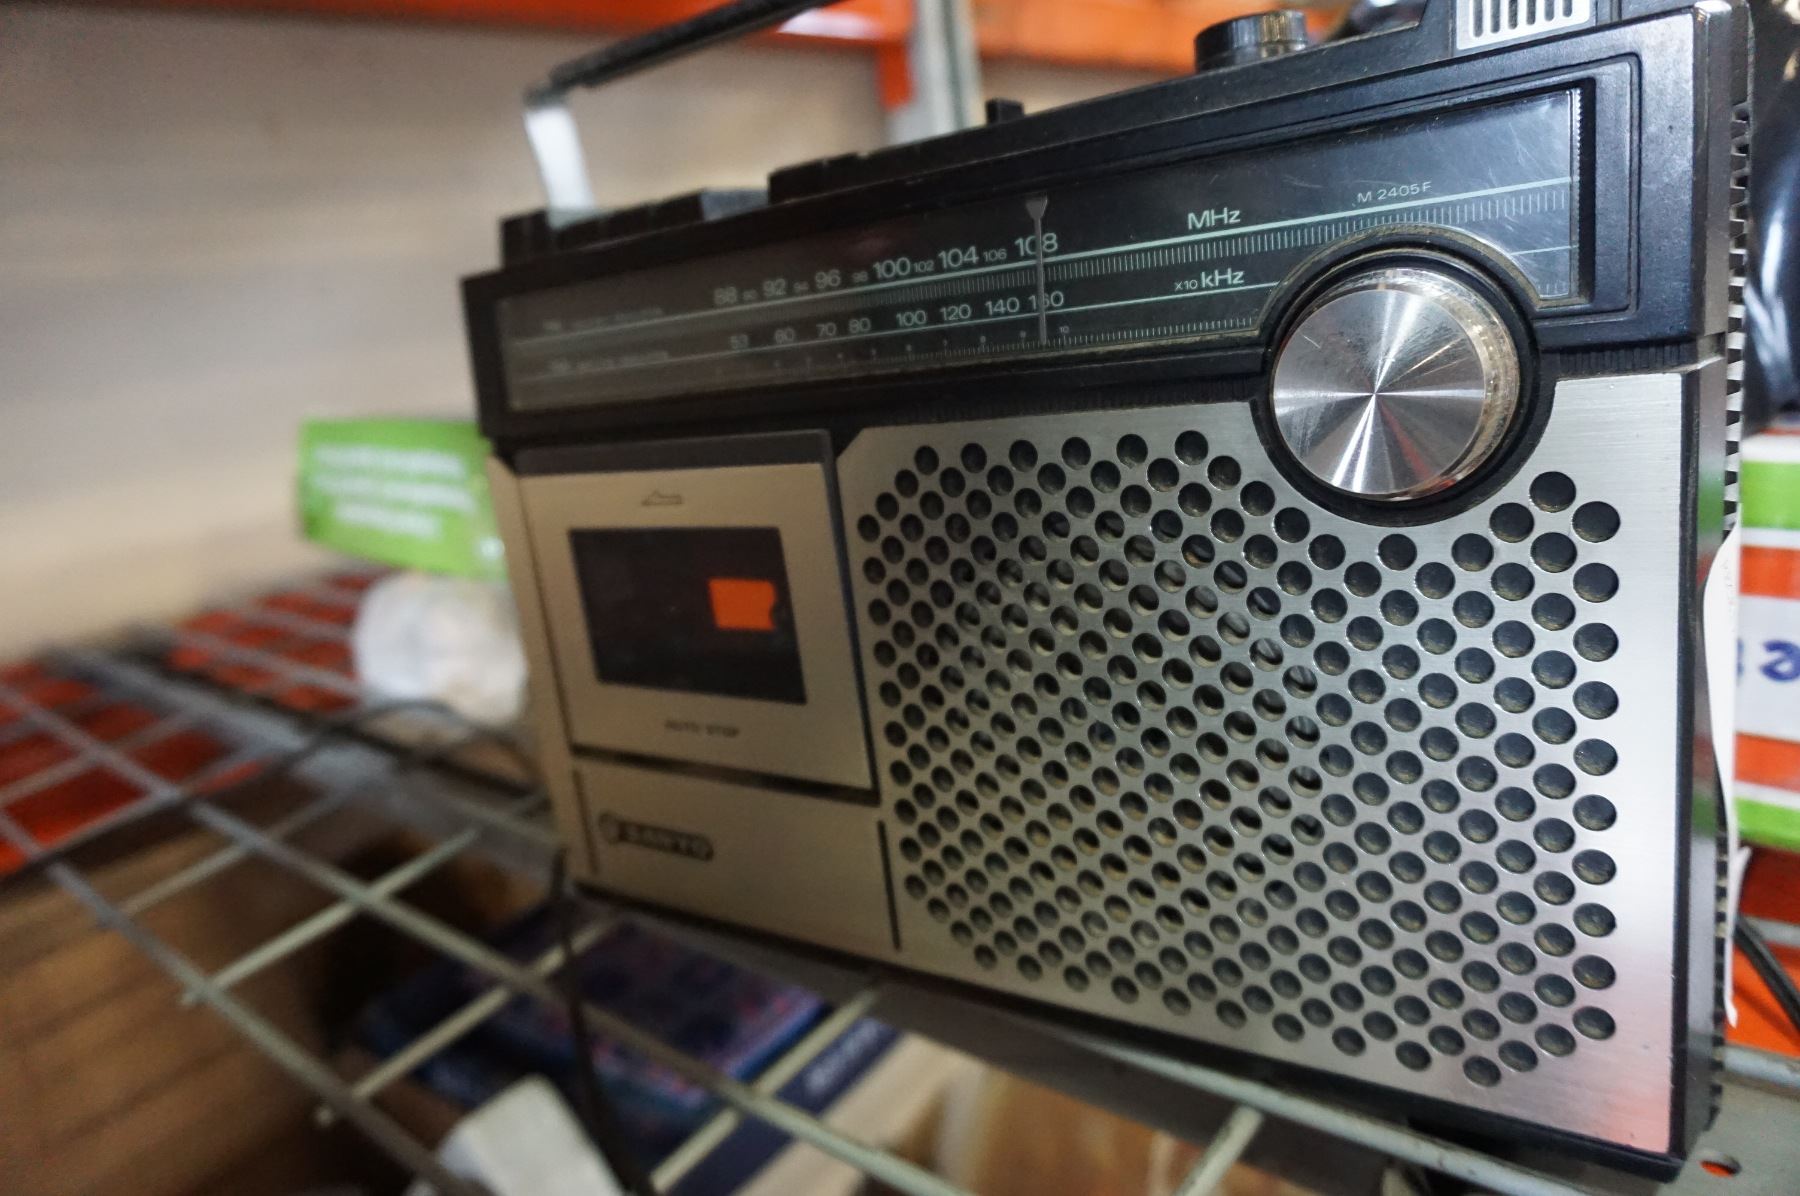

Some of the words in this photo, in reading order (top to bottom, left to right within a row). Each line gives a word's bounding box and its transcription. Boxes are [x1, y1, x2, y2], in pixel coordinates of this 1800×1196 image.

[763, 277, 787, 298] 92
[814, 268, 842, 290] 96
[872, 257, 911, 280] 100
[913, 260, 935, 273] 102
[937, 244, 980, 270] 104
[982, 248, 1008, 262] 106
[1187, 207, 1242, 231] MHz
[815, 321, 838, 339] 70
[895, 309, 928, 328] 100
[939, 303, 972, 322] 120
[985, 296, 1020, 316] 140
[1201, 267, 1245, 289] kHz
